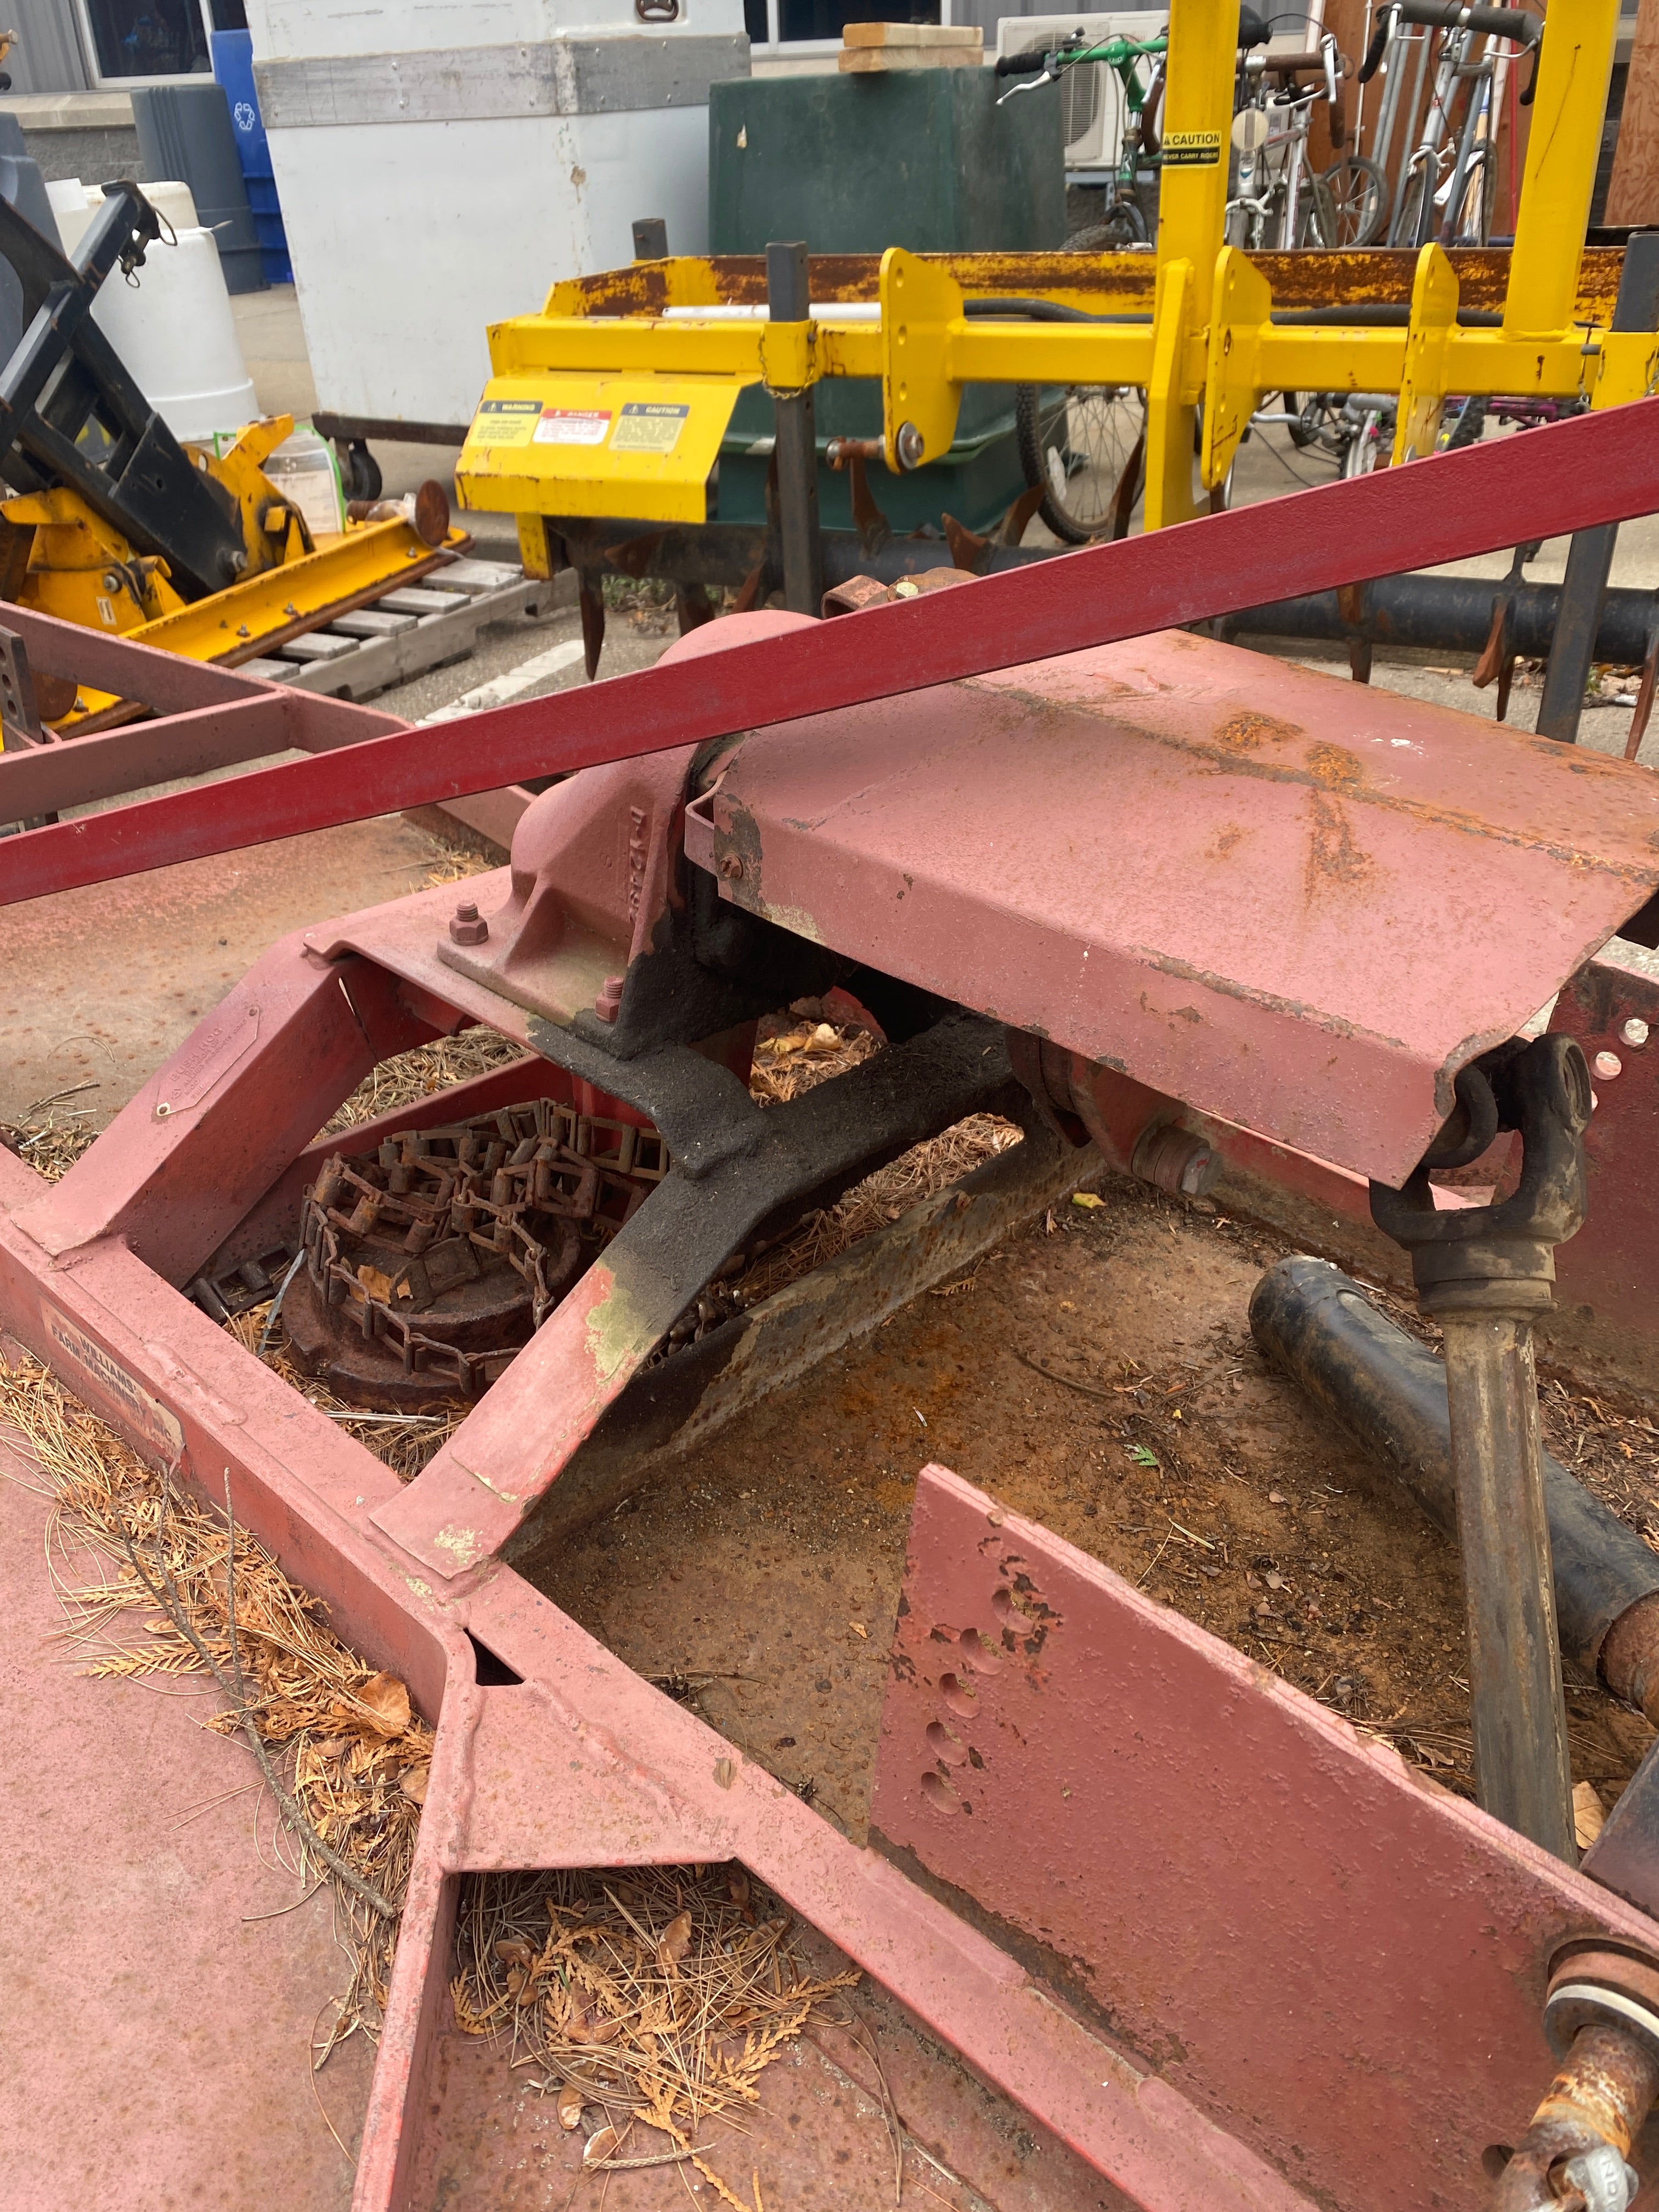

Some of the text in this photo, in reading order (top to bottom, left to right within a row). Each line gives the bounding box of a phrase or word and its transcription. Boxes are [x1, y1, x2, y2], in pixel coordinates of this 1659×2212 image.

[1172, 134, 1220, 145] CAUTION
[645, 407, 681, 415] CAUTION
[170, 1027, 223, 1082] BUSH HOG
[52, 1323, 81, 1360] FARM
[84, 1355, 146, 1419] MACHINERY
